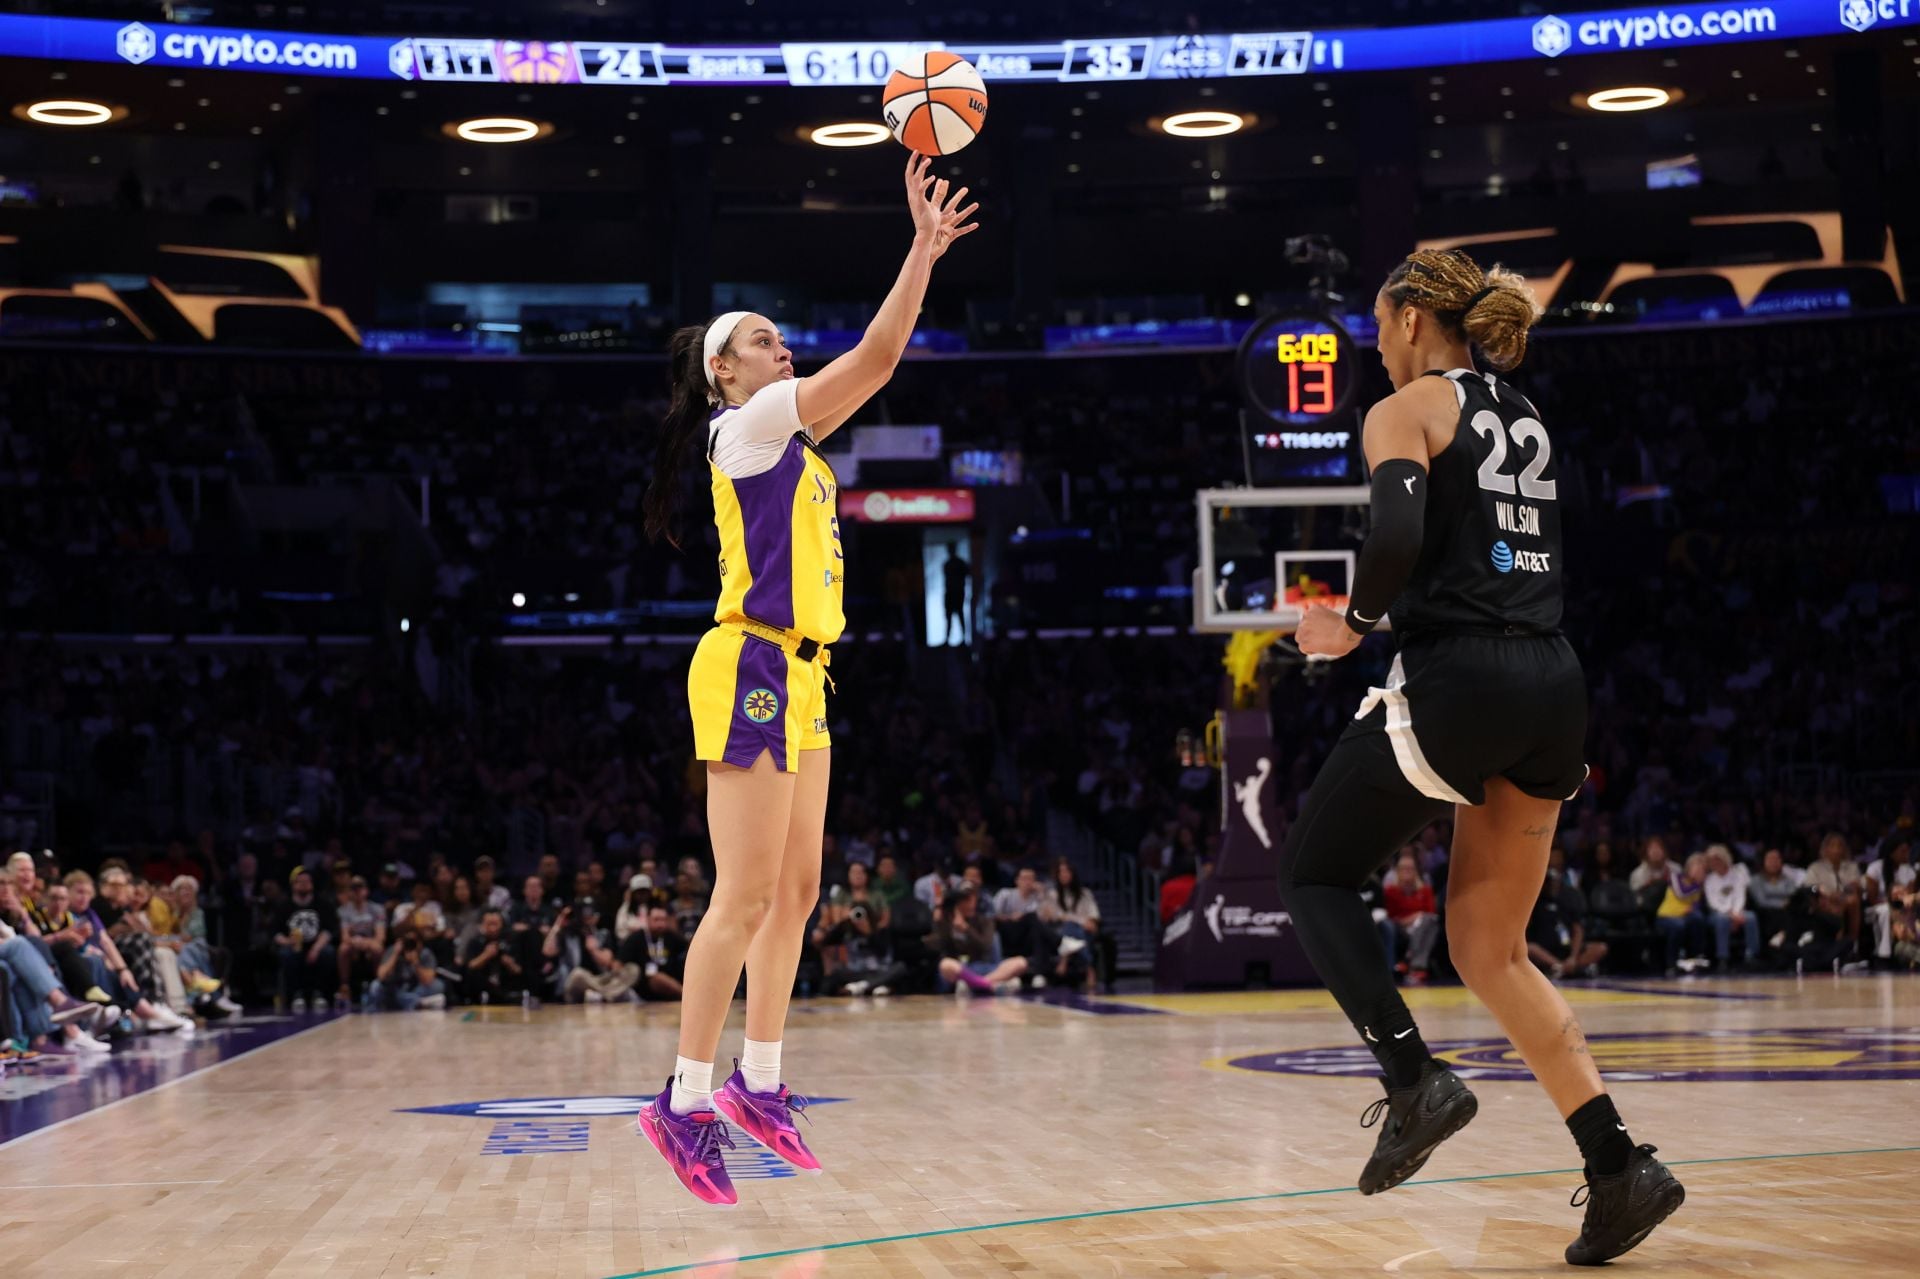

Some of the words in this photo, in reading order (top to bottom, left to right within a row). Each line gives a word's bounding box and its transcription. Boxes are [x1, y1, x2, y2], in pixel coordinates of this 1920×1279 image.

[1579, 7, 1776, 48] crypto.com
[163, 33, 357, 69] crypto.com
[597, 47, 644, 80] 24
[687, 54, 765, 79] Sparks
[806, 50, 889, 80] 6:10
[976, 53, 1031, 74] Aces
[1086, 44, 1132, 78] 35
[1158, 48, 1224, 69] ACES
[1278, 333, 1338, 363] 6:09
[1288, 363, 1334, 414] 13
[1280, 432, 1350, 448] TISSOT
[1471, 409, 1557, 500] 22
[1496, 501, 1541, 537] WILSON
[1514, 550, 1550, 573] AT&T
